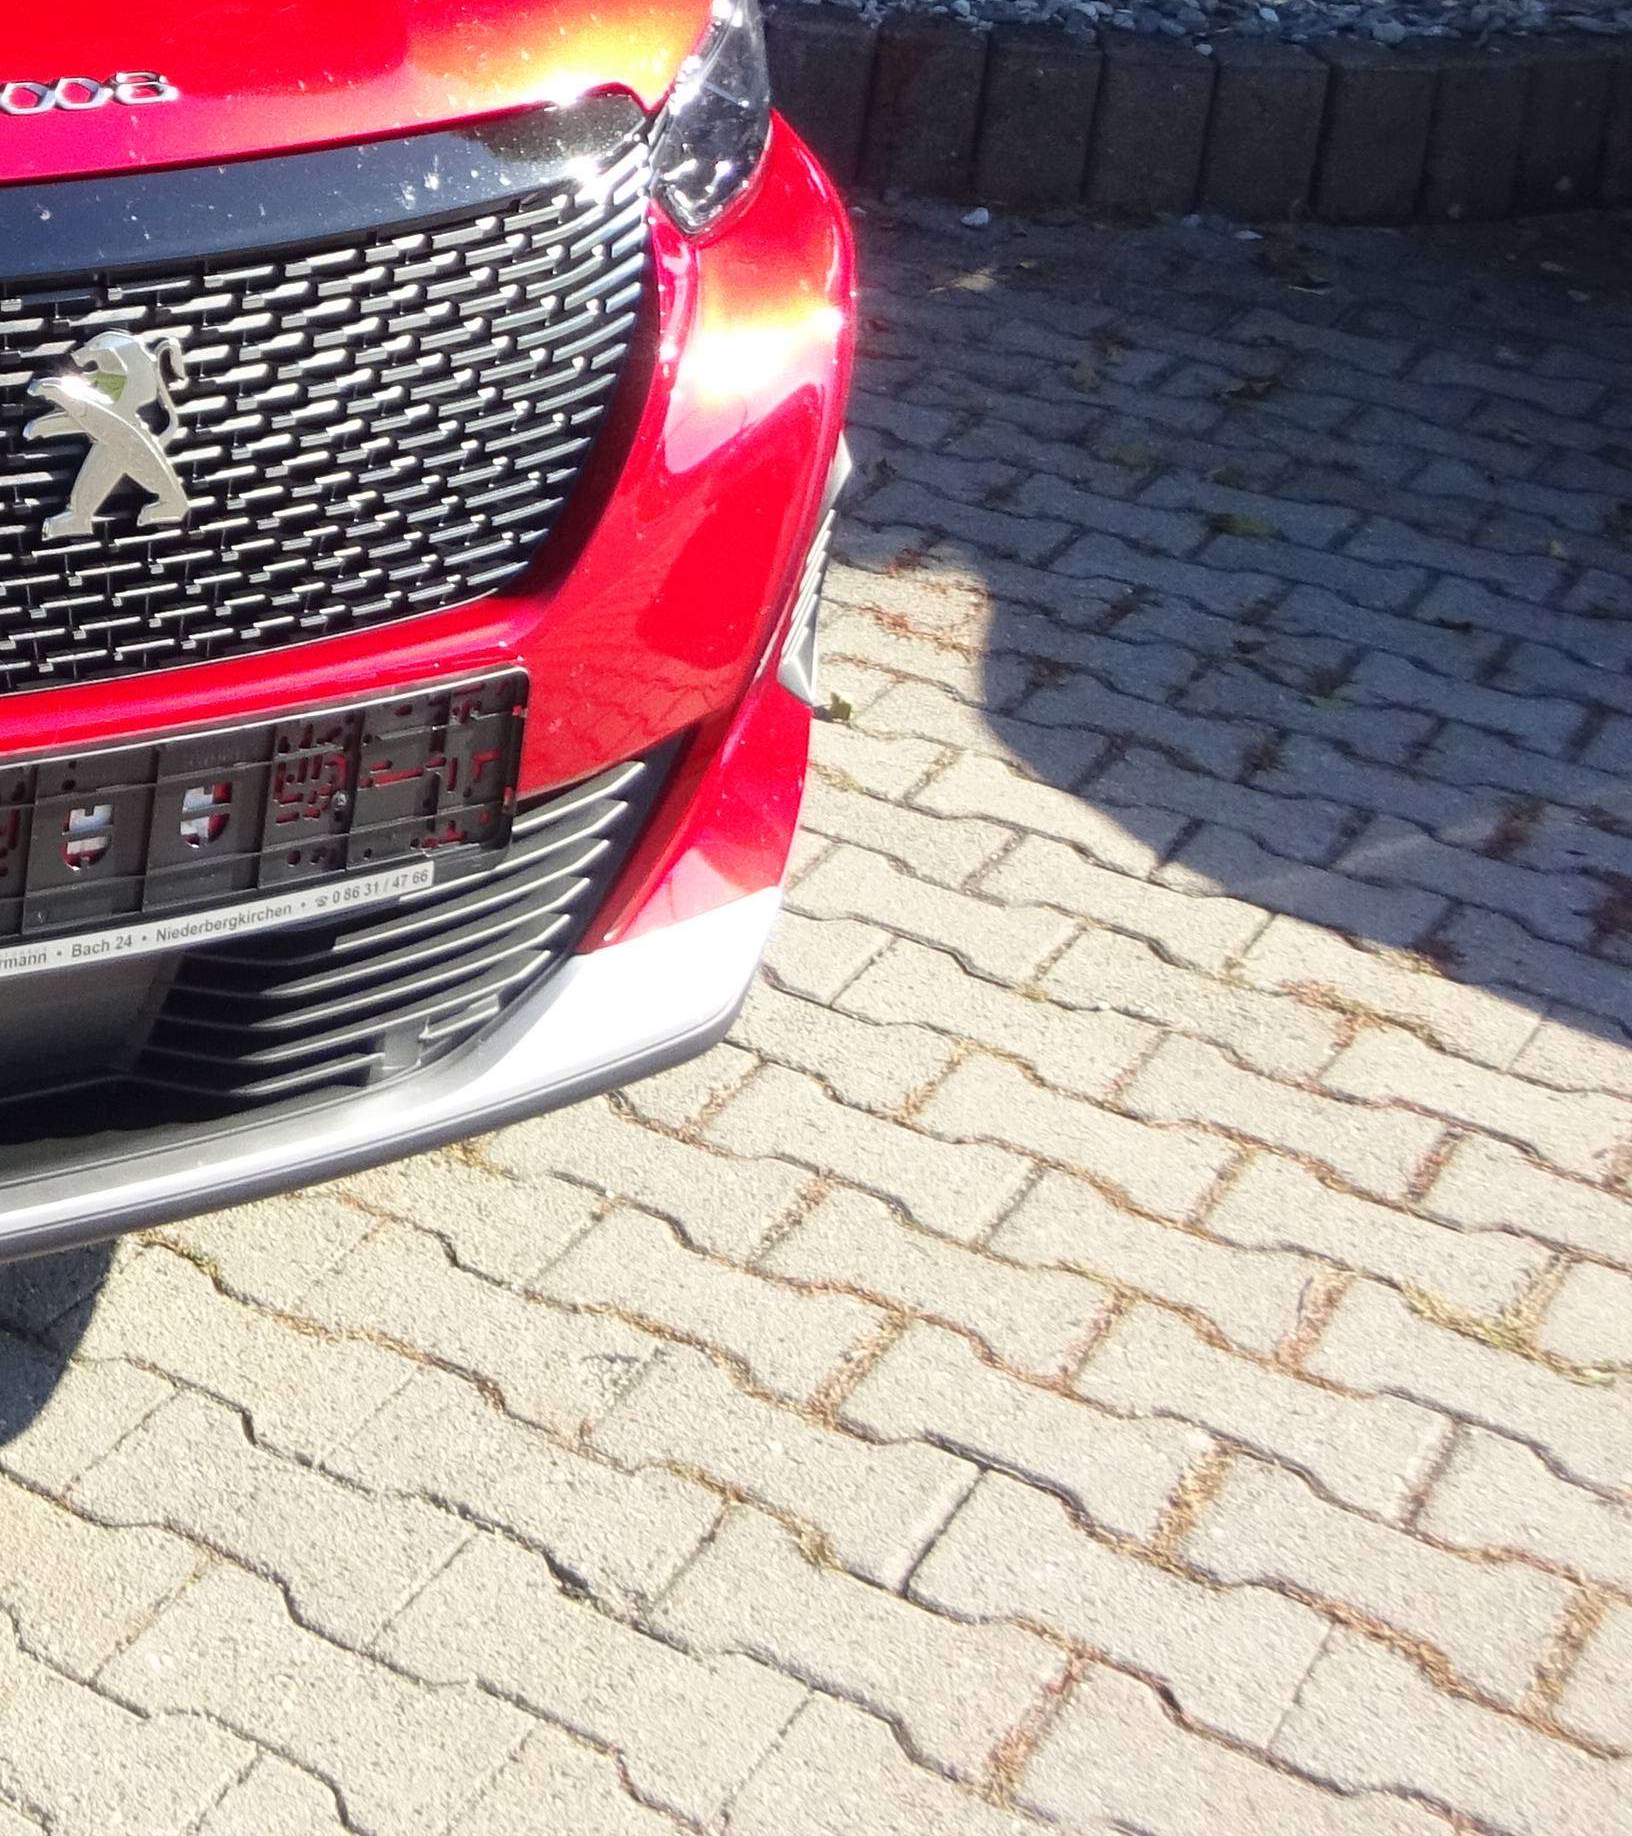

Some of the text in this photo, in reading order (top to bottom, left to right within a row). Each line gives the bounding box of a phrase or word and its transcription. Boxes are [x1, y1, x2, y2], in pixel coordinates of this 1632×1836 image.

[71, 938, 111, 959] Bach
[115, 934, 134, 950] 24
[155, 902, 293, 943] Niederbergkirchen
[332, 891, 342, 904] 0
[344, 885, 360, 901] 86
[364, 881, 380, 897] 31
[392, 874, 409, 890] 47
[412, 868, 429, 884] 66
